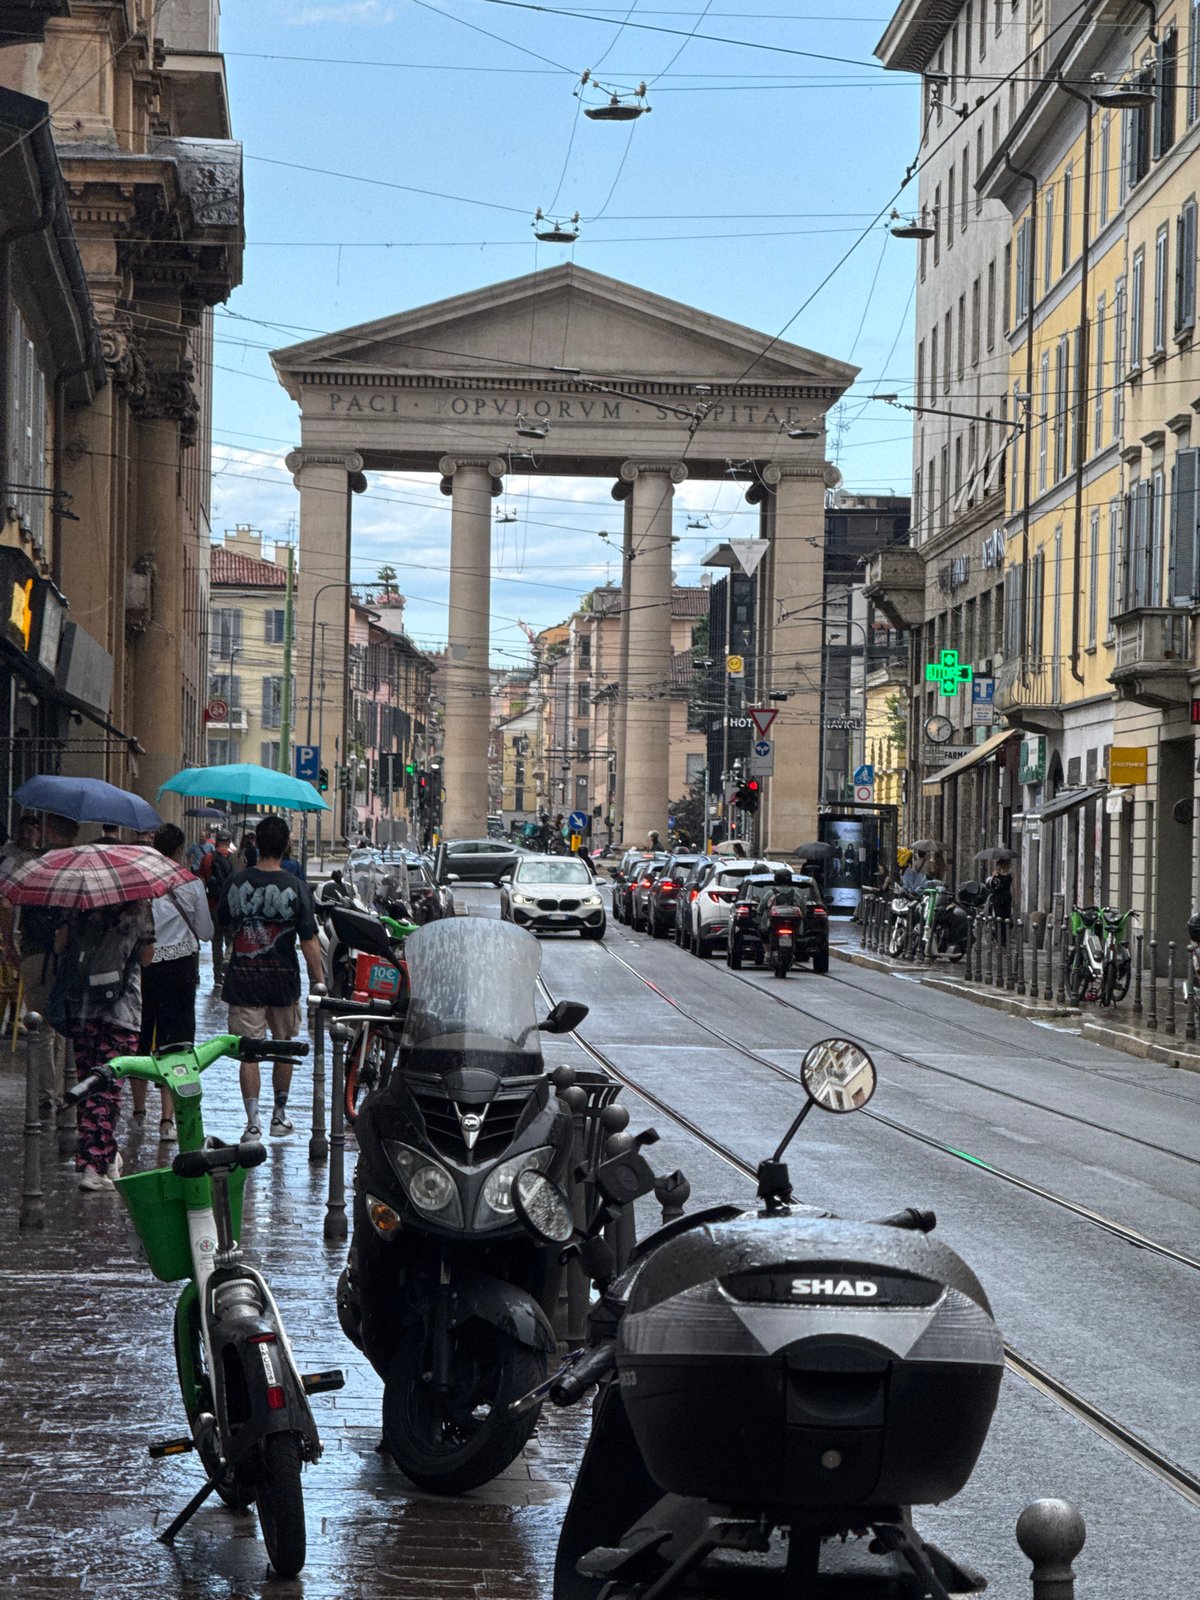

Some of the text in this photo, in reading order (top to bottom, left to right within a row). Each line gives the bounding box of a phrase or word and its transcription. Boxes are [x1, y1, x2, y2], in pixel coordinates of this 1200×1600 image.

[329, 393, 800, 424] PACI POPVLORVM SOPITAE
[300, 748, 314, 765] P
[373, 966, 397, 980] 10€
[791, 1279, 878, 1297] SHAD
